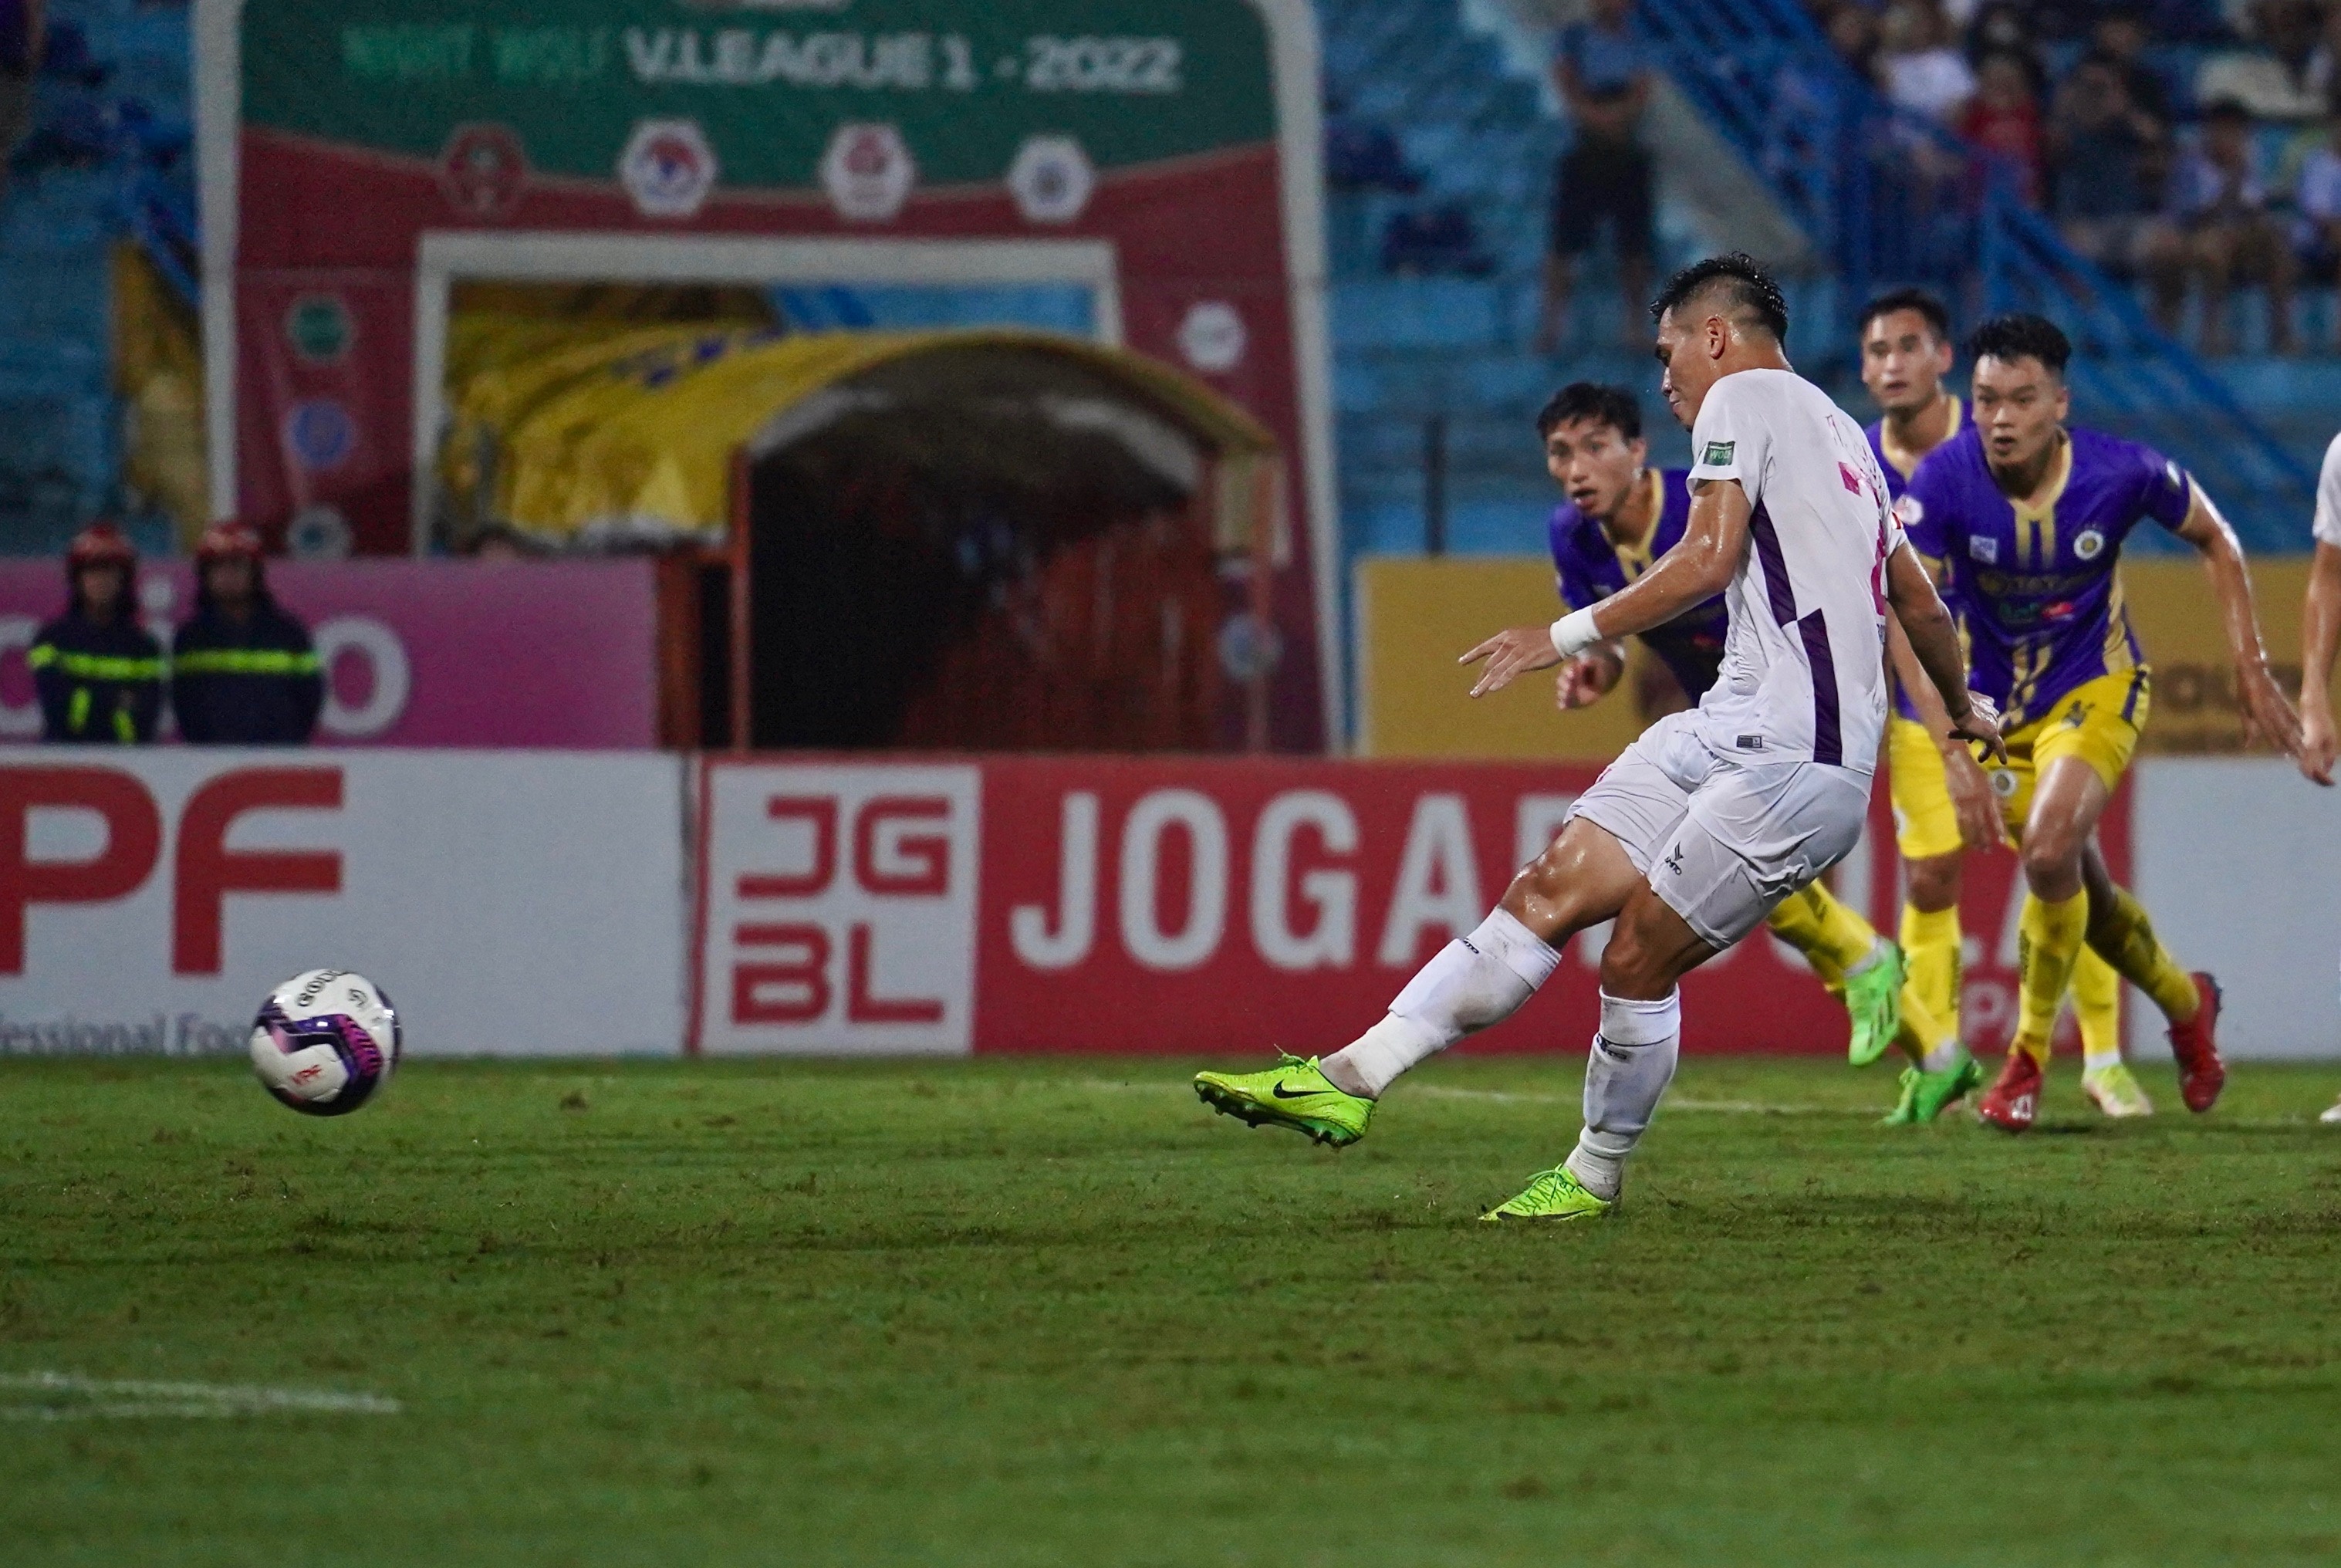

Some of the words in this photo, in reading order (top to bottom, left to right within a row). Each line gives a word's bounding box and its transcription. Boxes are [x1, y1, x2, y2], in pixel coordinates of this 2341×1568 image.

[623, 28, 926, 85] V.LEAGUE
[1025, 35, 1184, 93] 2022
[736, 795, 950, 898] JG
[730, 922, 946, 1024] BL
